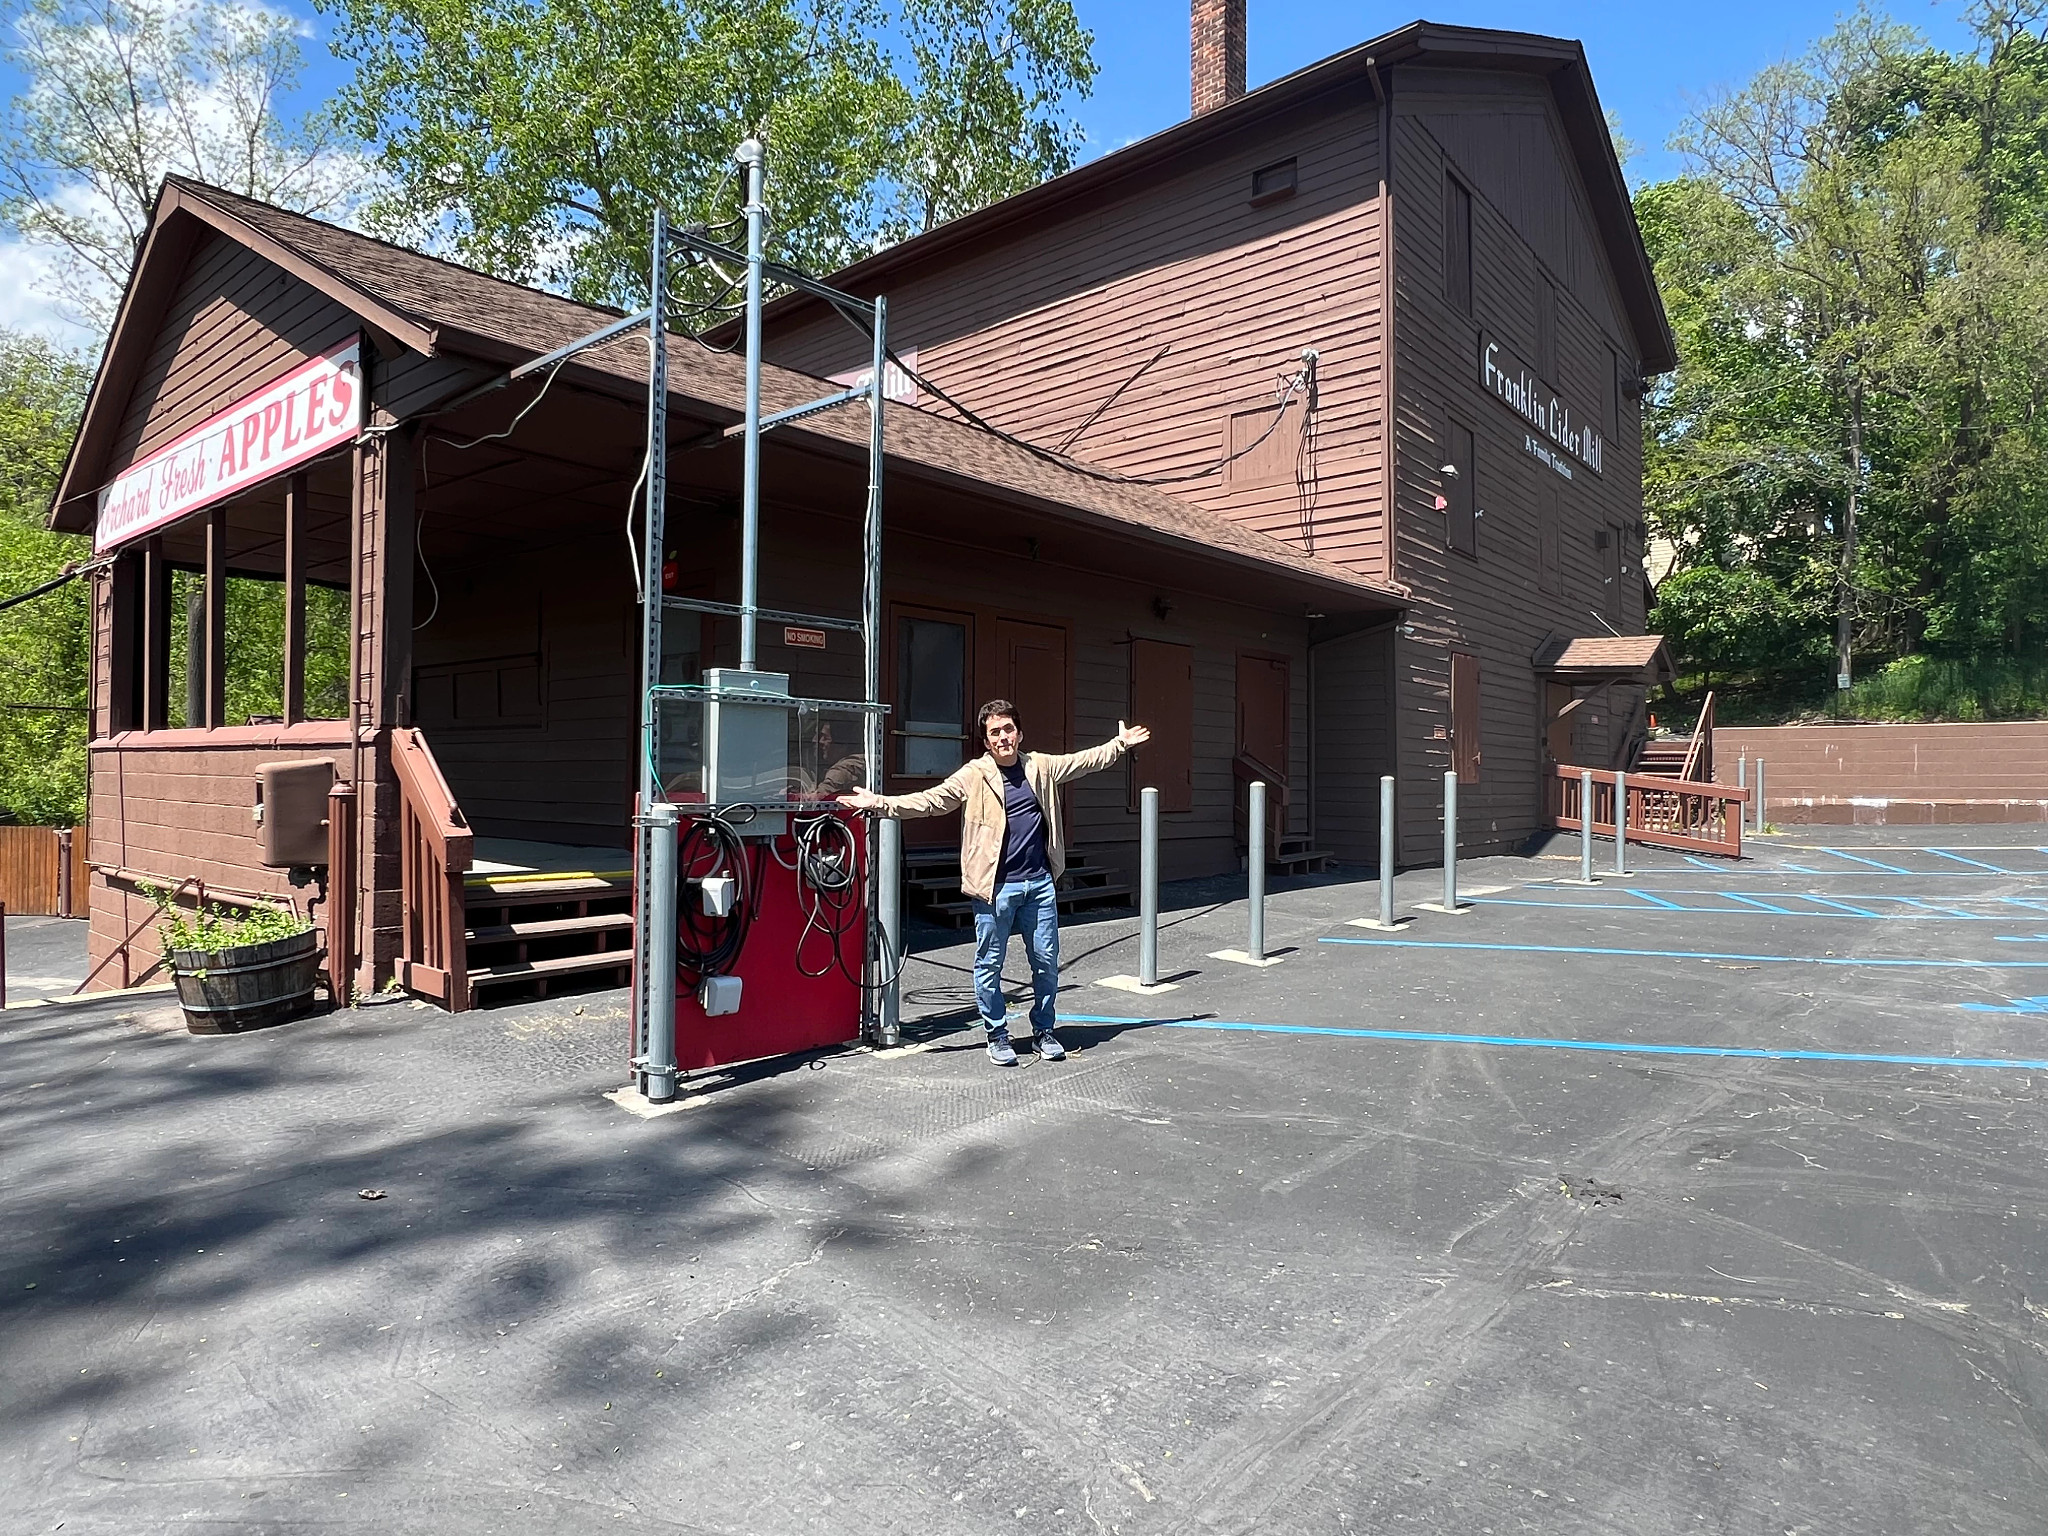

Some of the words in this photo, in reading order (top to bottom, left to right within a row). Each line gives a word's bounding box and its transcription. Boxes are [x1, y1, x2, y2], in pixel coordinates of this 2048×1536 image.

[1485, 342, 1546, 430] Franklin
[1549, 397, 1580, 455] Cider
[1583, 425, 1602, 474] Mill
[1525, 434, 1532, 452] A
[101, 467, 154, 540] Orchard
[159, 438, 205, 510] Fresh
[217, 359, 353, 482] APPLES
[787, 631, 797, 642] NO
[797, 632, 824, 645] SMOKING
